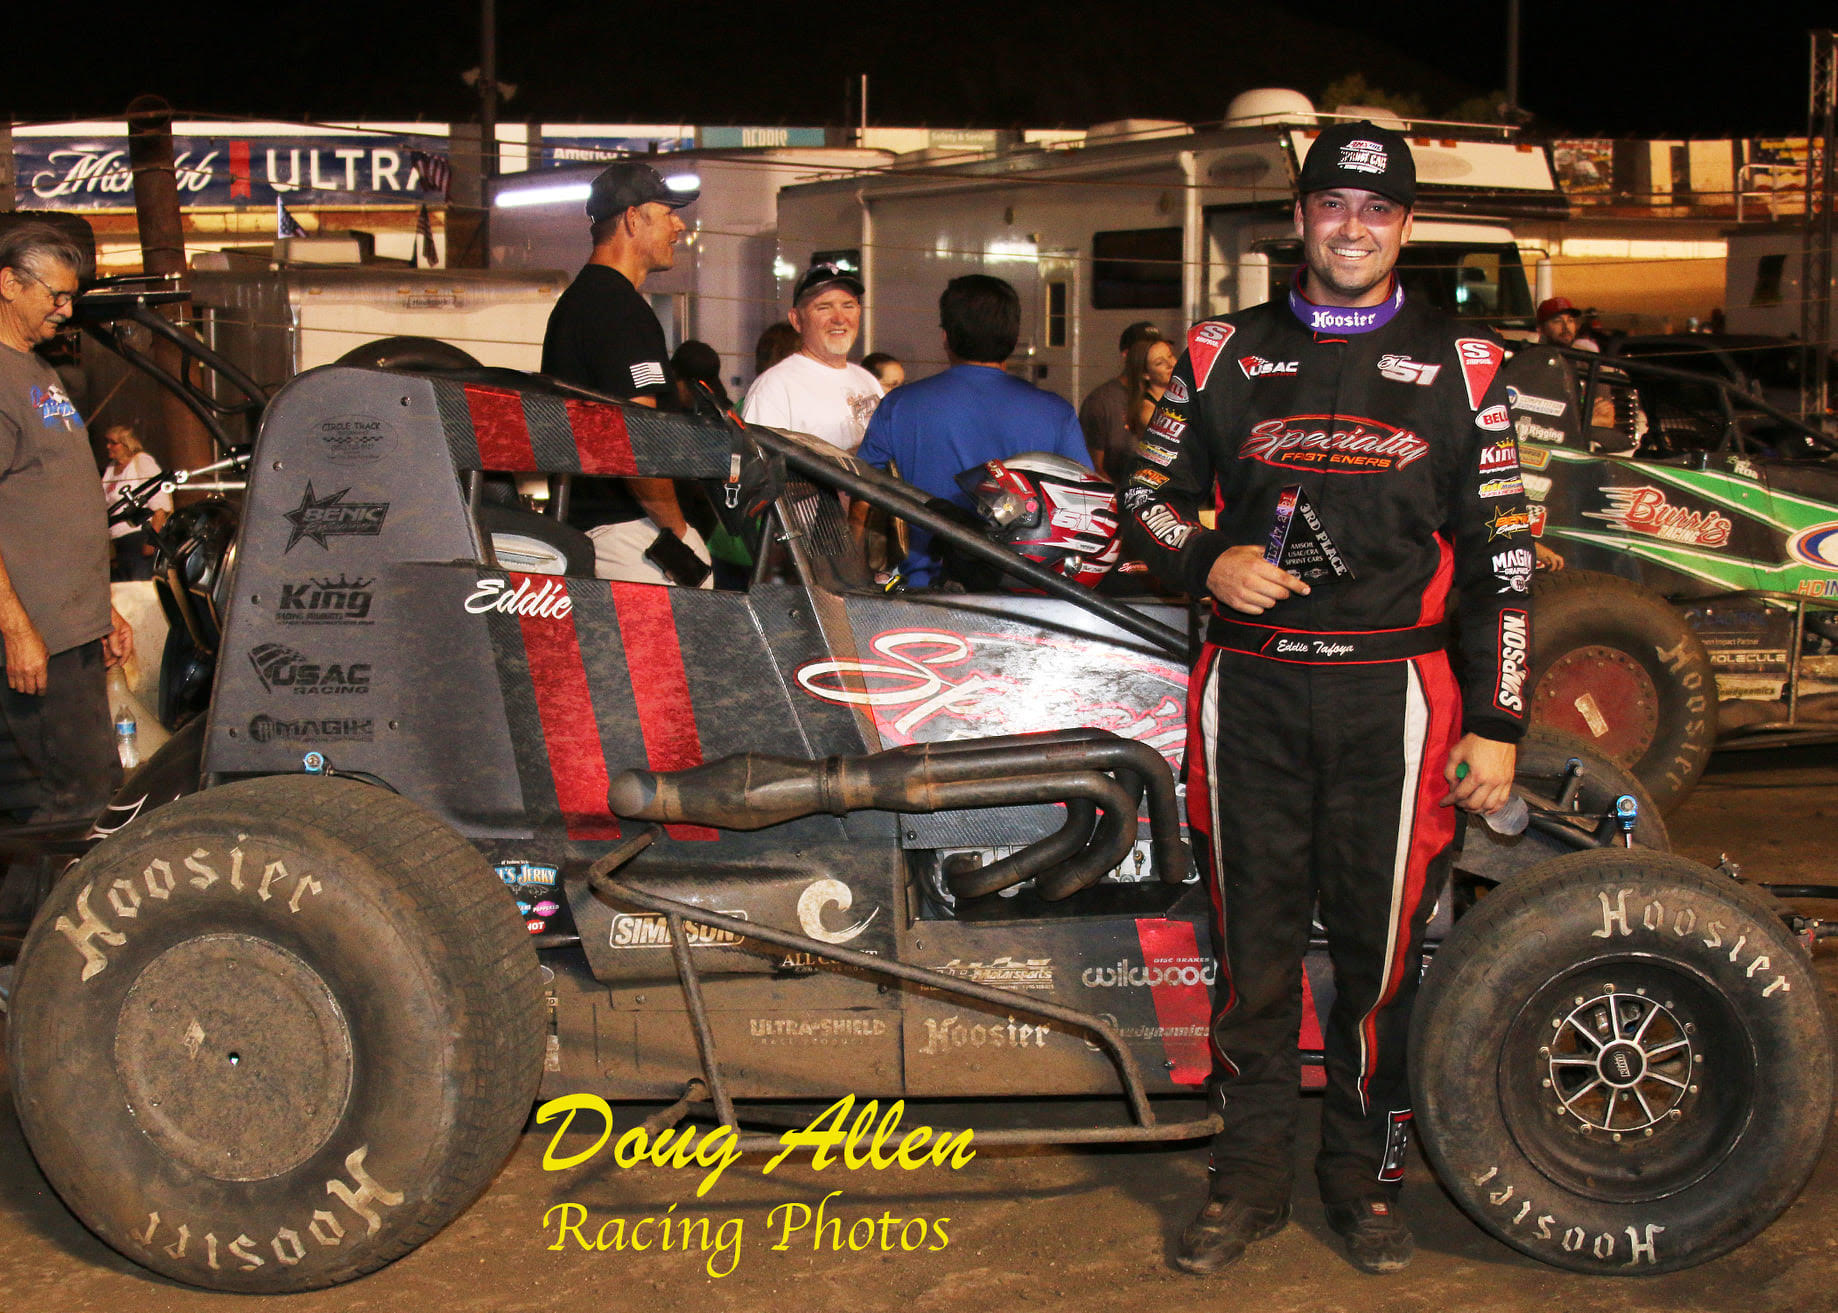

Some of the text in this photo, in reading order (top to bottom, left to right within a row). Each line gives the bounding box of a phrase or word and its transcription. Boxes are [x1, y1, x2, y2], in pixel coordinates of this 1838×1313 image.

[32, 149, 219, 199] Micob
[1311, 311, 1377, 328] Hoosier
[1249, 362, 1299, 376] USAC
[1239, 420, 1430, 471] Specialty
[303, 508, 382, 523] BENK
[1625, 487, 1732, 545] Burris
[1300, 503, 1347, 576] 3RD PLACE
[279, 583, 373, 618] King
[464, 577, 574, 620] Eddie
[1277, 639, 1355, 656] Eddie Tafoya
[1499, 615, 1527, 711] SIMPSON
[271, 663, 372, 686] USAC
[293, 686, 370, 695] RACING
[276, 719, 374, 736] MAGIK
[517, 865, 555, 885] JERKY
[54, 832, 323, 982] Hoosier
[615, 917, 735, 945] SIMSON
[1591, 888, 1792, 998] Hoosier
[1081, 959, 1218, 988] wilwood
[918, 1014, 1051, 1055] Hoosier
[131, 1144, 405, 1272] Hoosier
[1471, 1166, 1667, 1267] Hoosier
